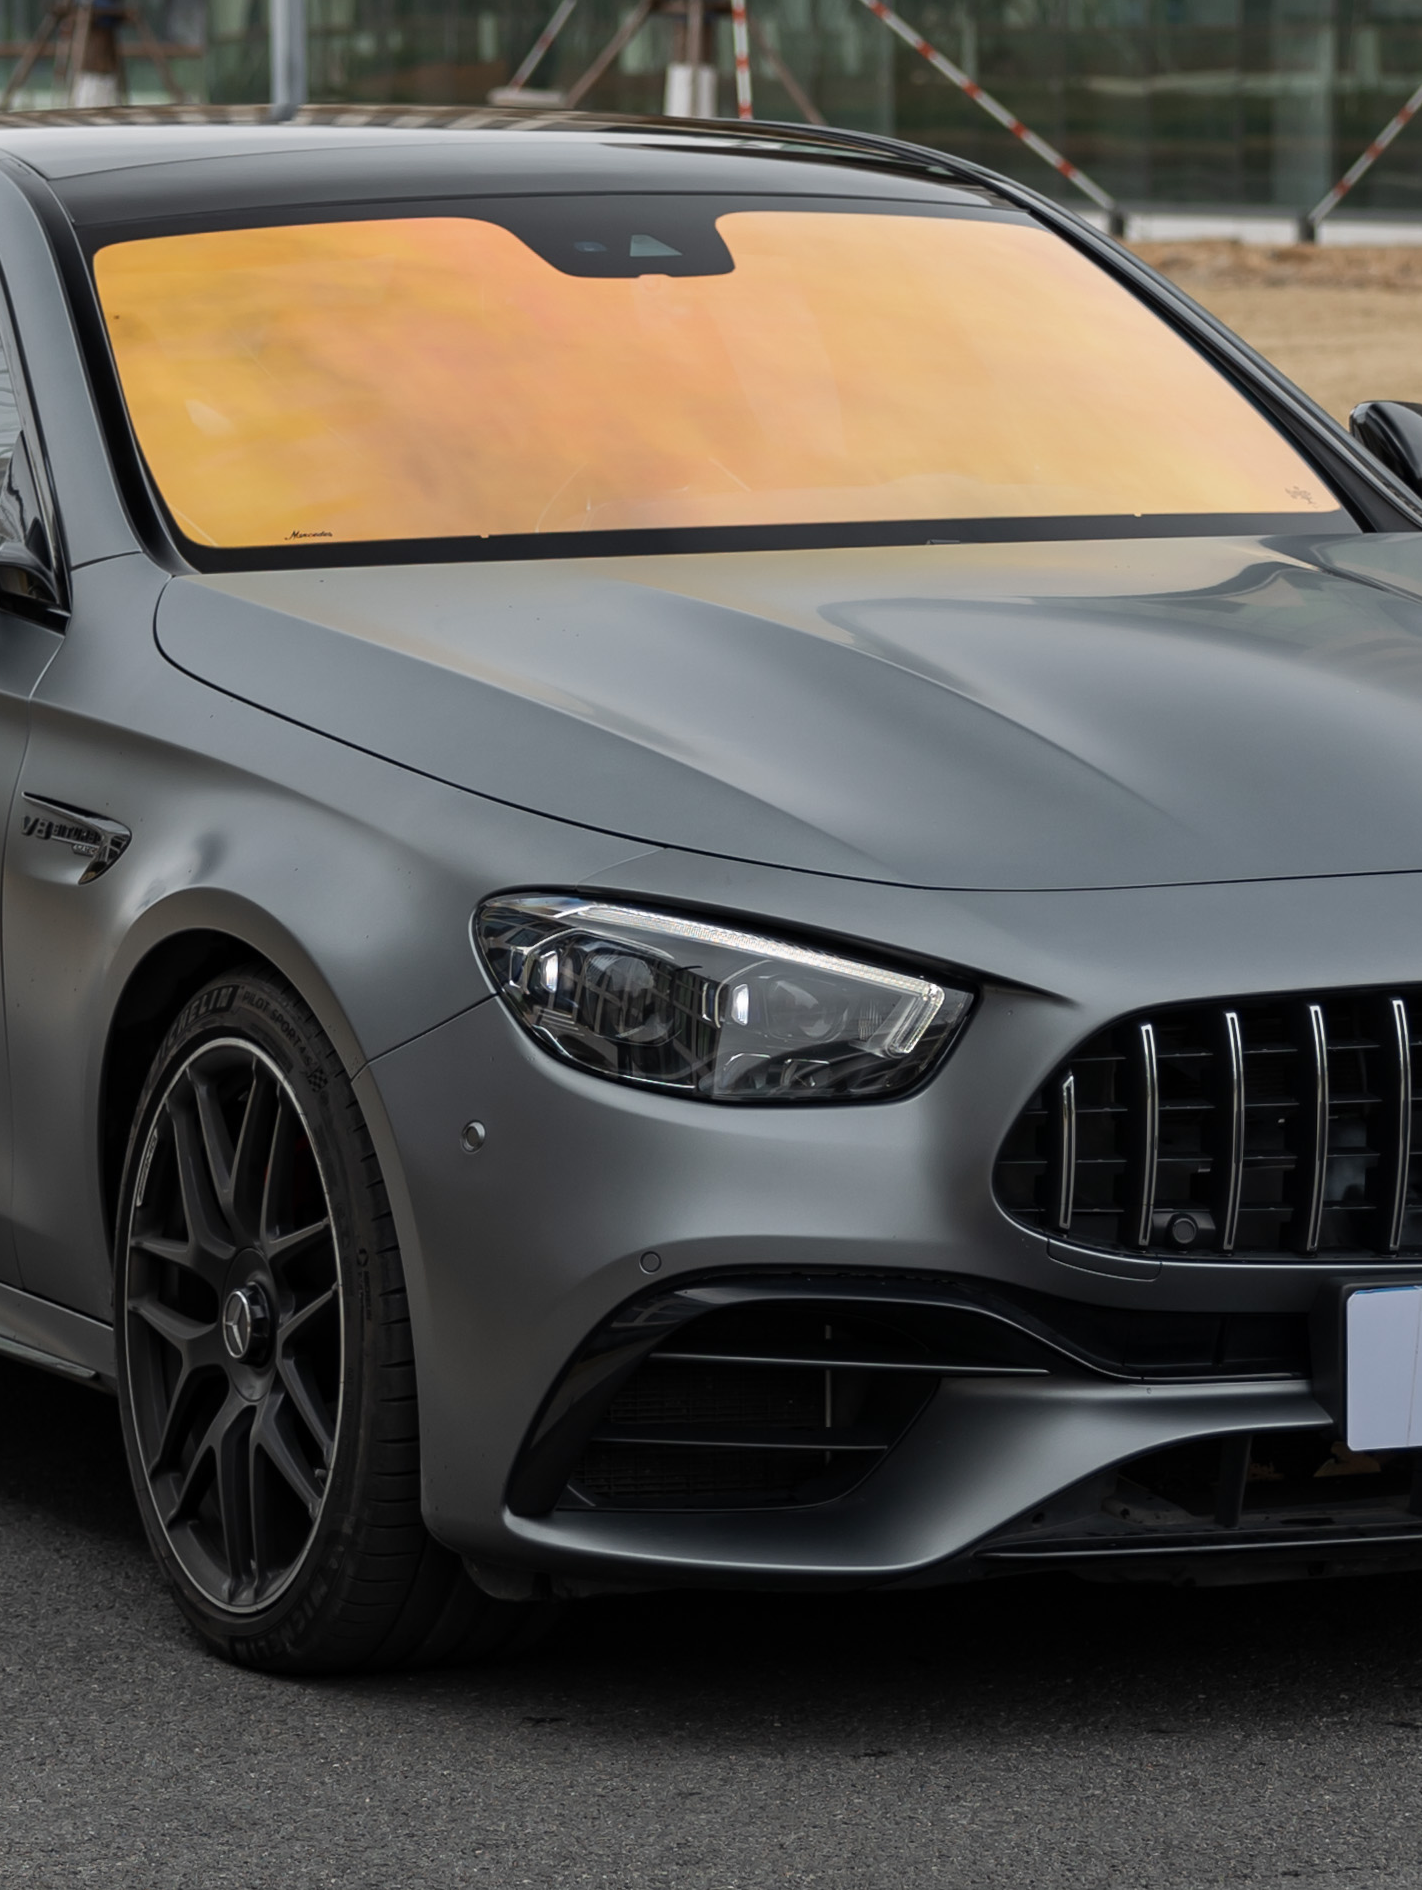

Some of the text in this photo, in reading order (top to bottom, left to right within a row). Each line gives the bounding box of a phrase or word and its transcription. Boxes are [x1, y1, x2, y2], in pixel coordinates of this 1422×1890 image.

[22, 816, 53, 840] V8
[242, 991, 270, 1013] PILOT
[271, 1010, 303, 1048] SPORT
